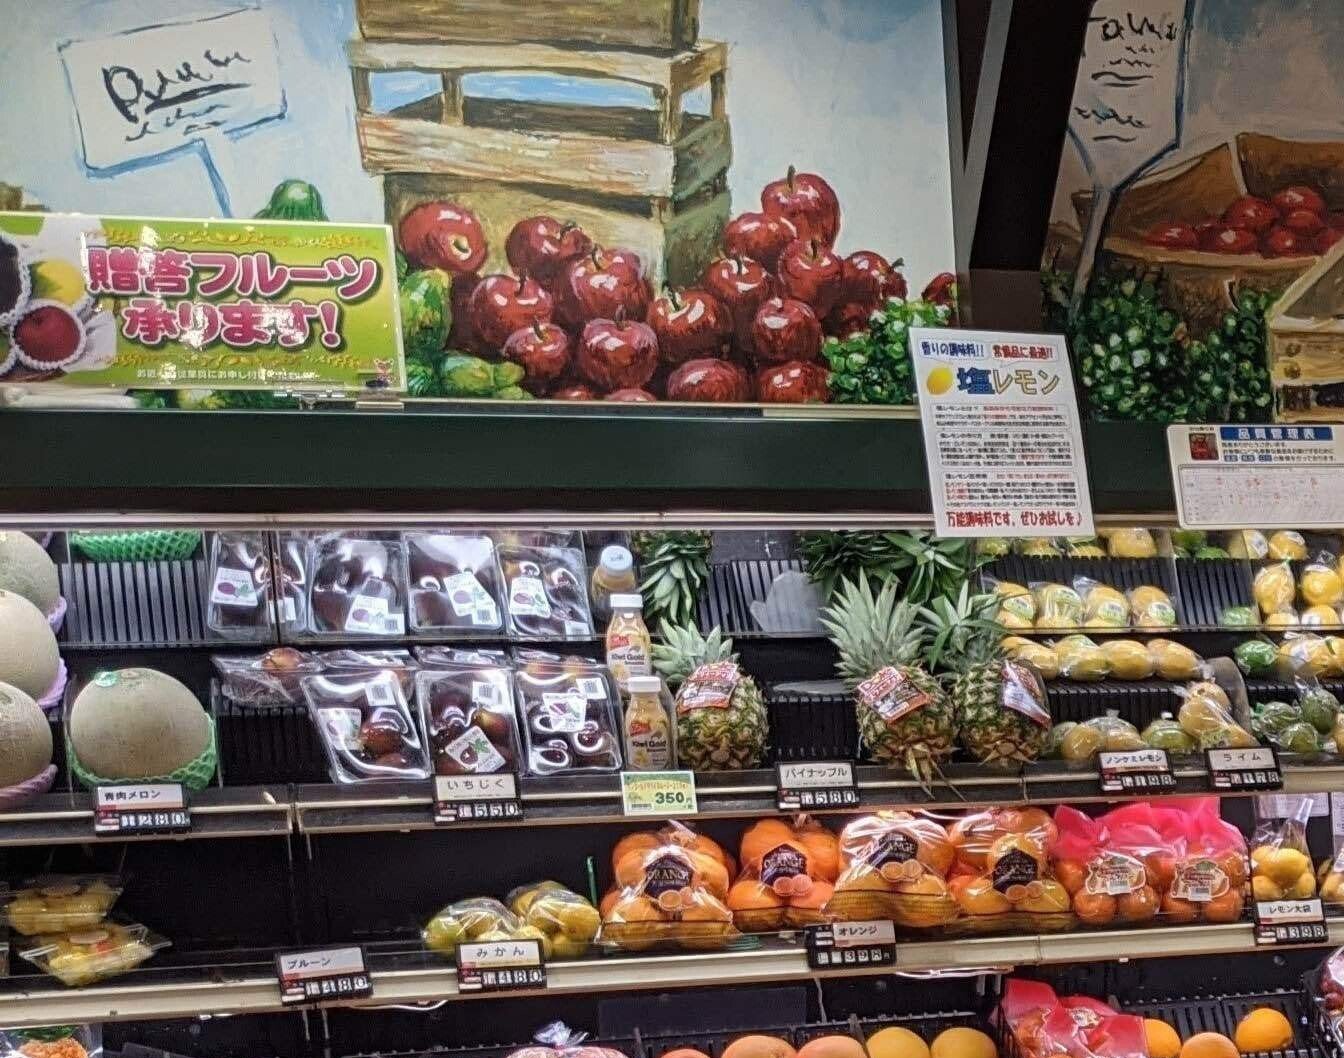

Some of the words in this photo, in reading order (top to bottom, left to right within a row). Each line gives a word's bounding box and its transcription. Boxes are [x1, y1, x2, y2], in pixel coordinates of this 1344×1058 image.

[957, 367, 1060, 395] 塩レモン
[1223, 752, 1260, 763] ライム
[786, 767, 848, 779] パイナップル
[447, 779, 506, 791] いちじく
[838, 925, 878, 937] オレンジ
[476, 947, 526, 958] みかん
